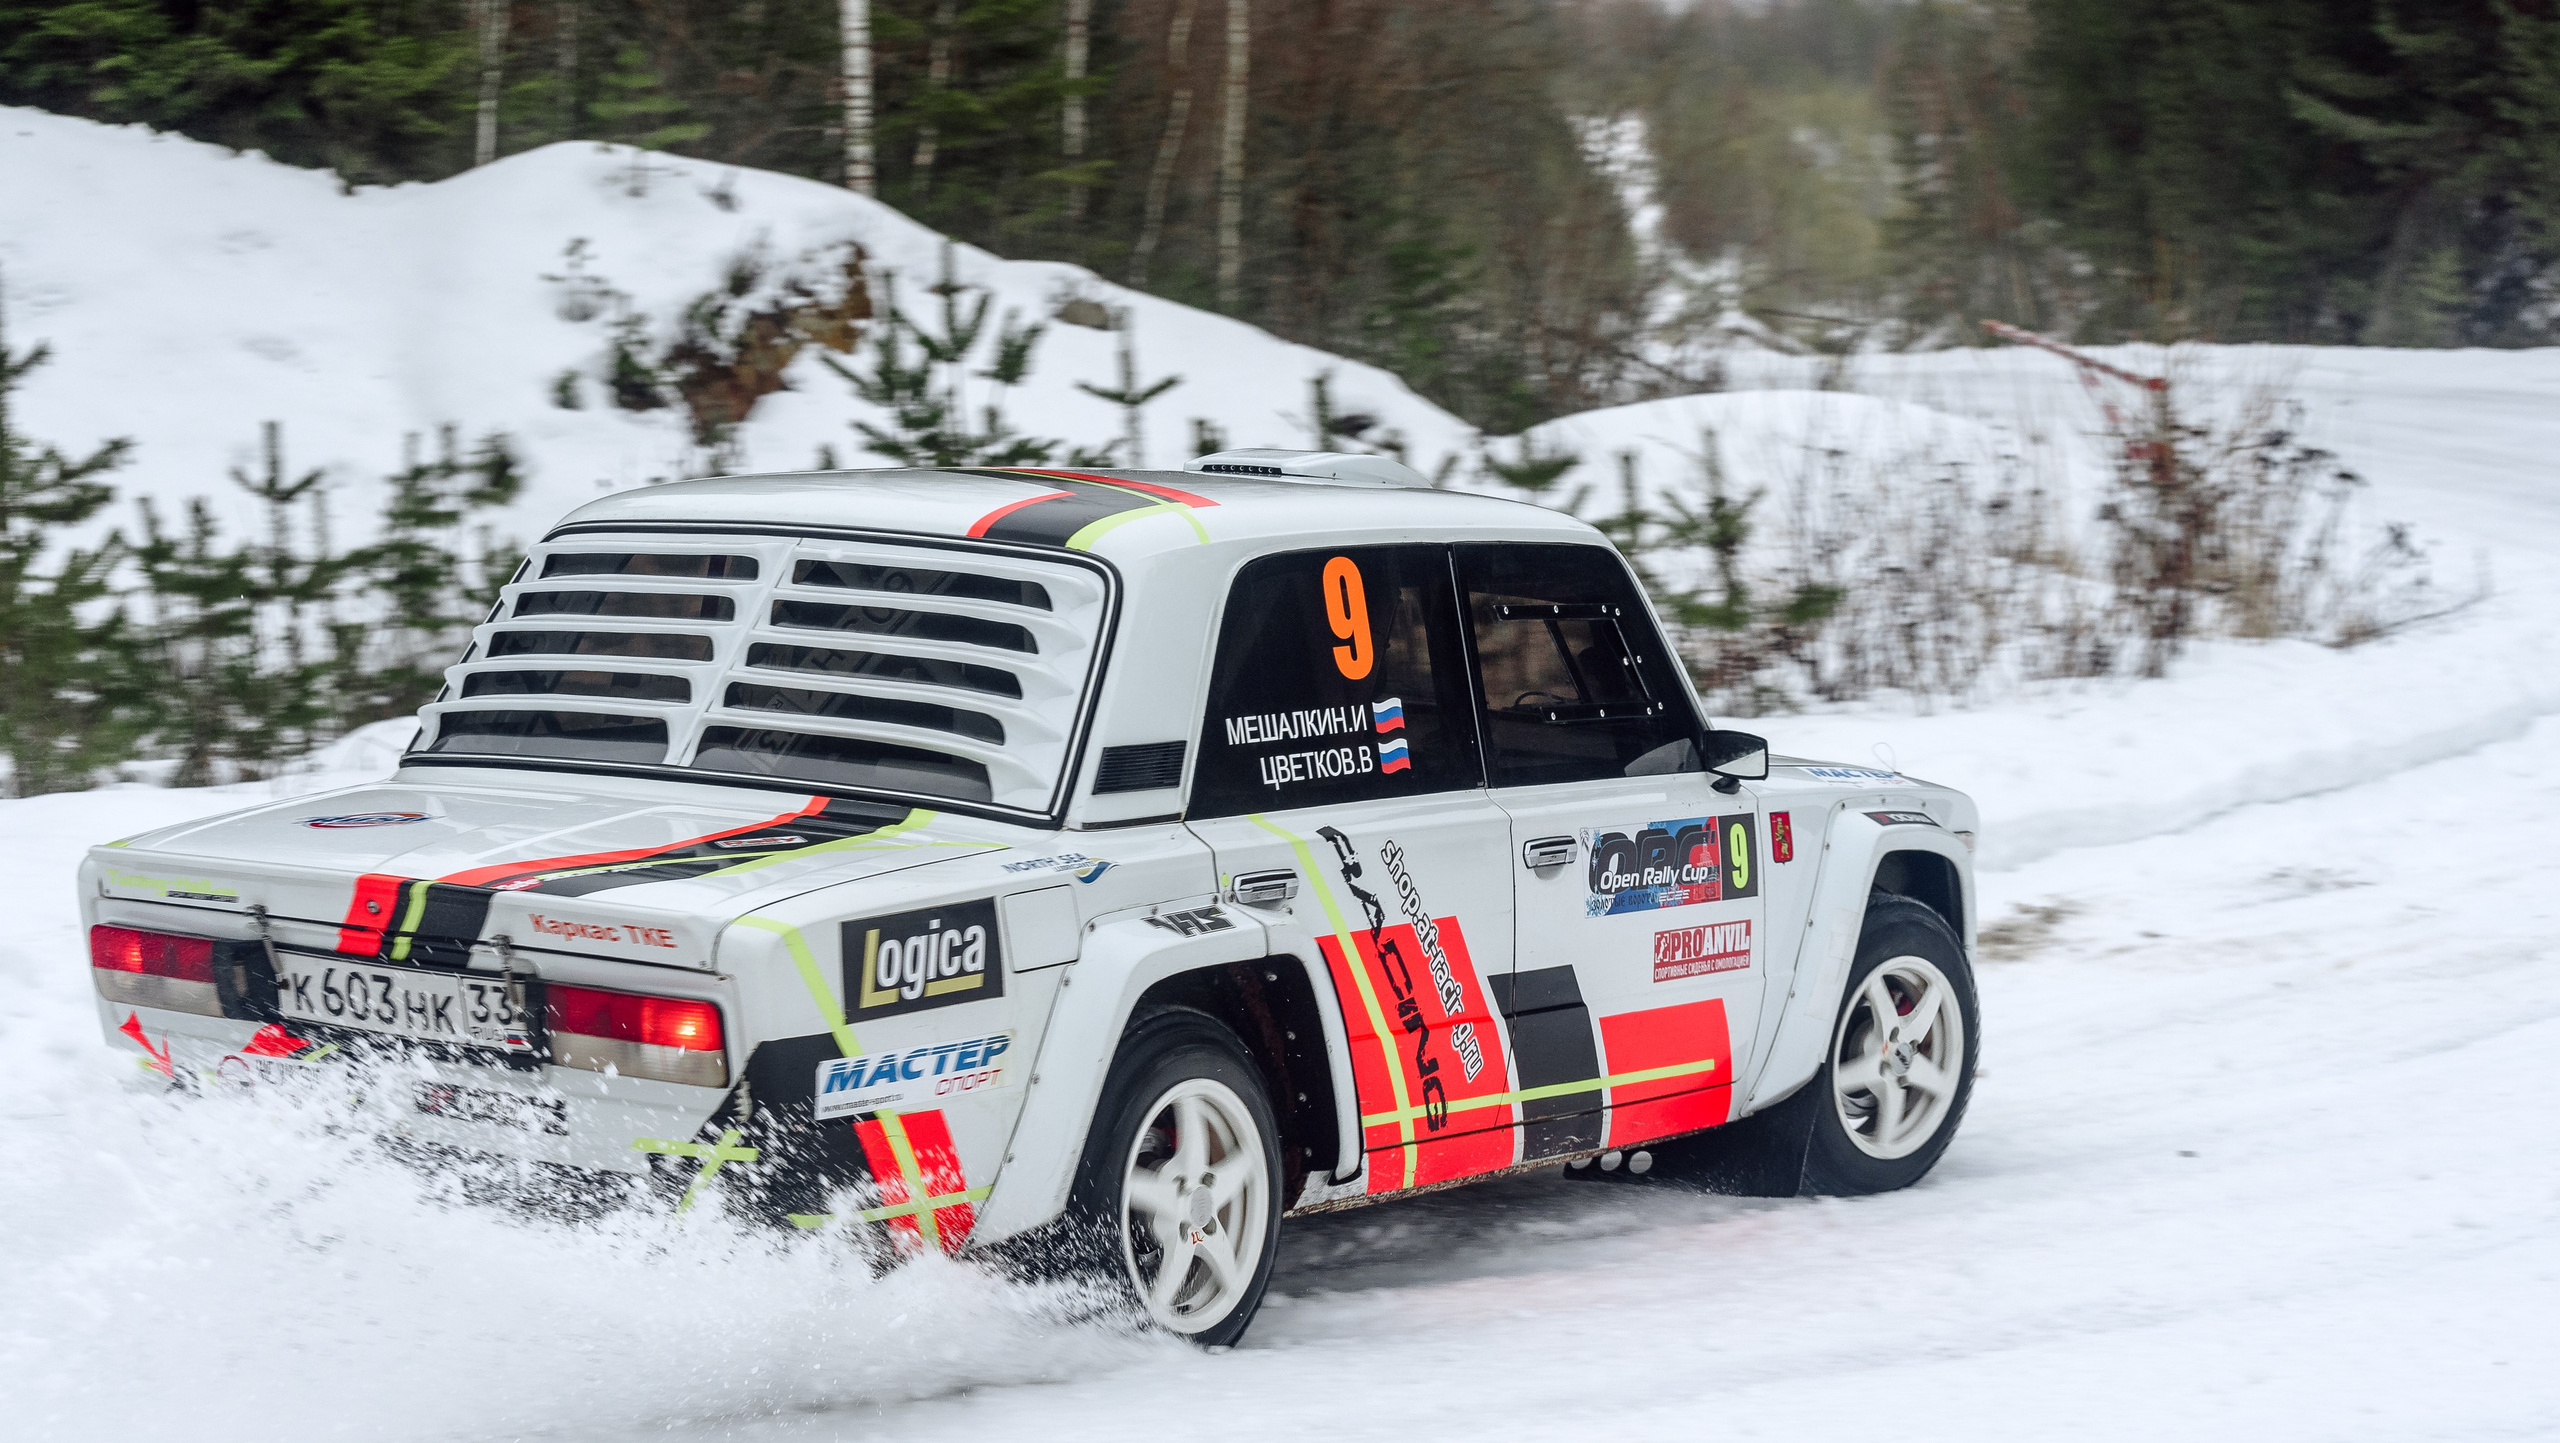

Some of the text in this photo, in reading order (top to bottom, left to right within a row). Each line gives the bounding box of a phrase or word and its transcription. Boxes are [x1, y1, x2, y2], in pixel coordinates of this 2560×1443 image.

[1322, 556, 1374, 681] 9
[1225, 704, 1368, 745] МЕШАЛКИН.И
[1259, 745, 1374, 790] ЦВЕТКОВ.В
[1001, 853, 1090, 873] NORTH SEA
[1729, 822, 1749, 889] 9
[1600, 863, 1709, 893] Open Rally Cup
[528, 913, 621, 942] Каркас
[1670, 922, 1750, 962] PROANVIL
[859, 918, 987, 1010] Logica
[822, 1034, 1012, 1094] МАСТЕР
[934, 1068, 1003, 1096] СПОРТ
